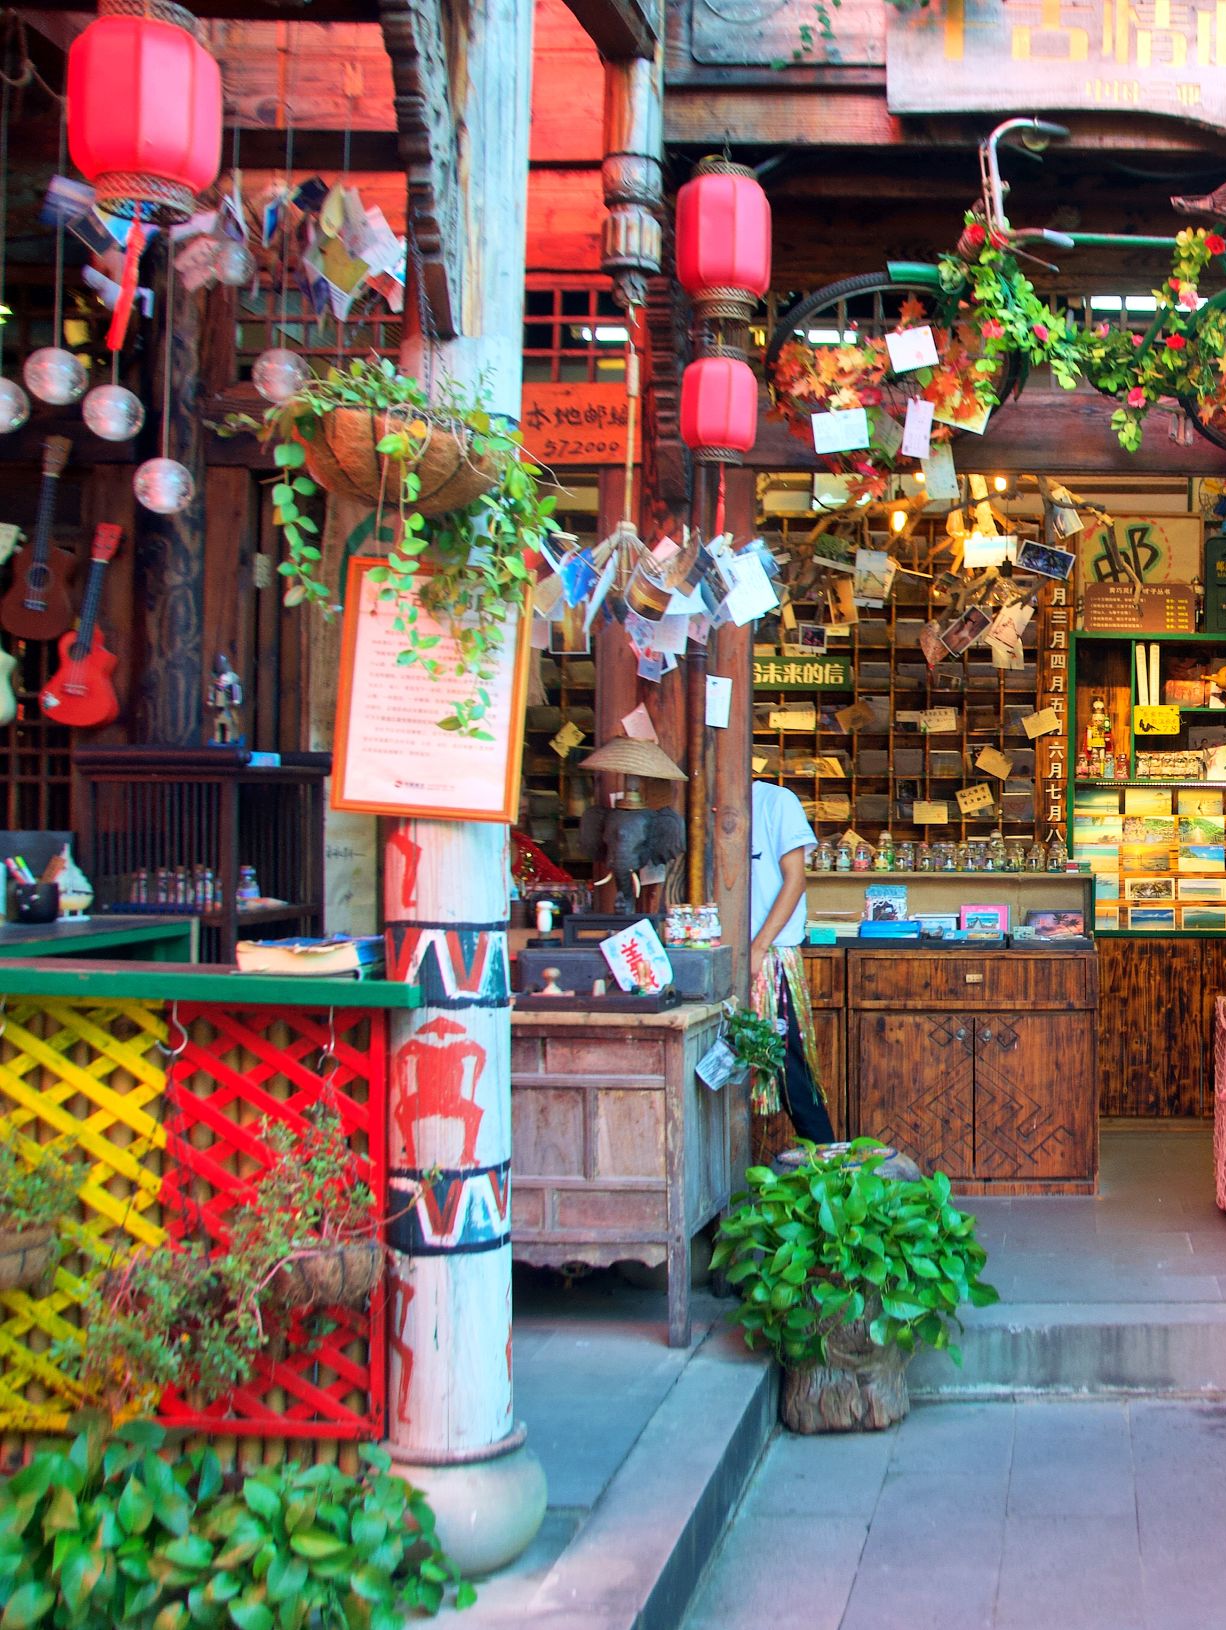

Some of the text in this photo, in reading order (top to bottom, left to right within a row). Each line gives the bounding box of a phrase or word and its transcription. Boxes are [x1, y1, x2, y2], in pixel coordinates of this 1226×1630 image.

[544, 439, 621, 457] 572000
[1050, 611, 1067, 649] 三月
[1049, 654, 1066, 692] 四月
[1048, 742, 1065, 779] 六月
[1045, 784, 1062, 822] 七月
